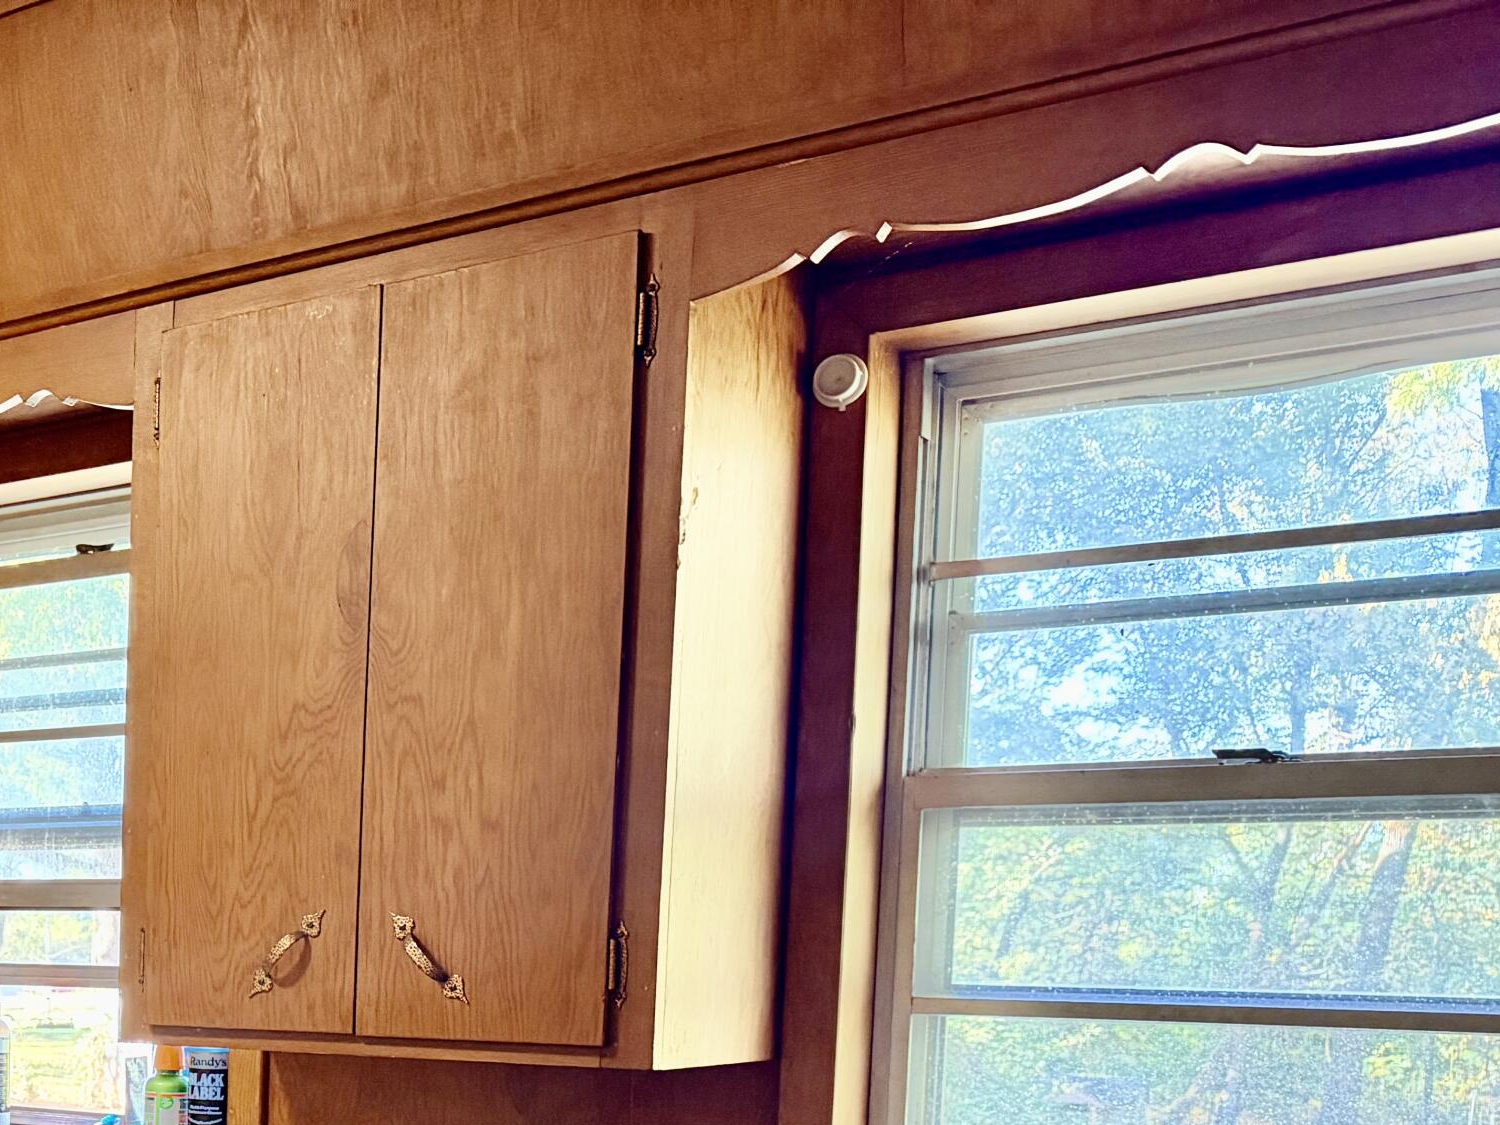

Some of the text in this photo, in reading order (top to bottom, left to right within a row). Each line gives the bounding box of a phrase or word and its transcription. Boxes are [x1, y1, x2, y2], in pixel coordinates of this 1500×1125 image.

[190, 1056, 227, 1068] Randy's
[188, 1073, 224, 1087] BLACK
[188, 1087, 224, 1100] LABEL
